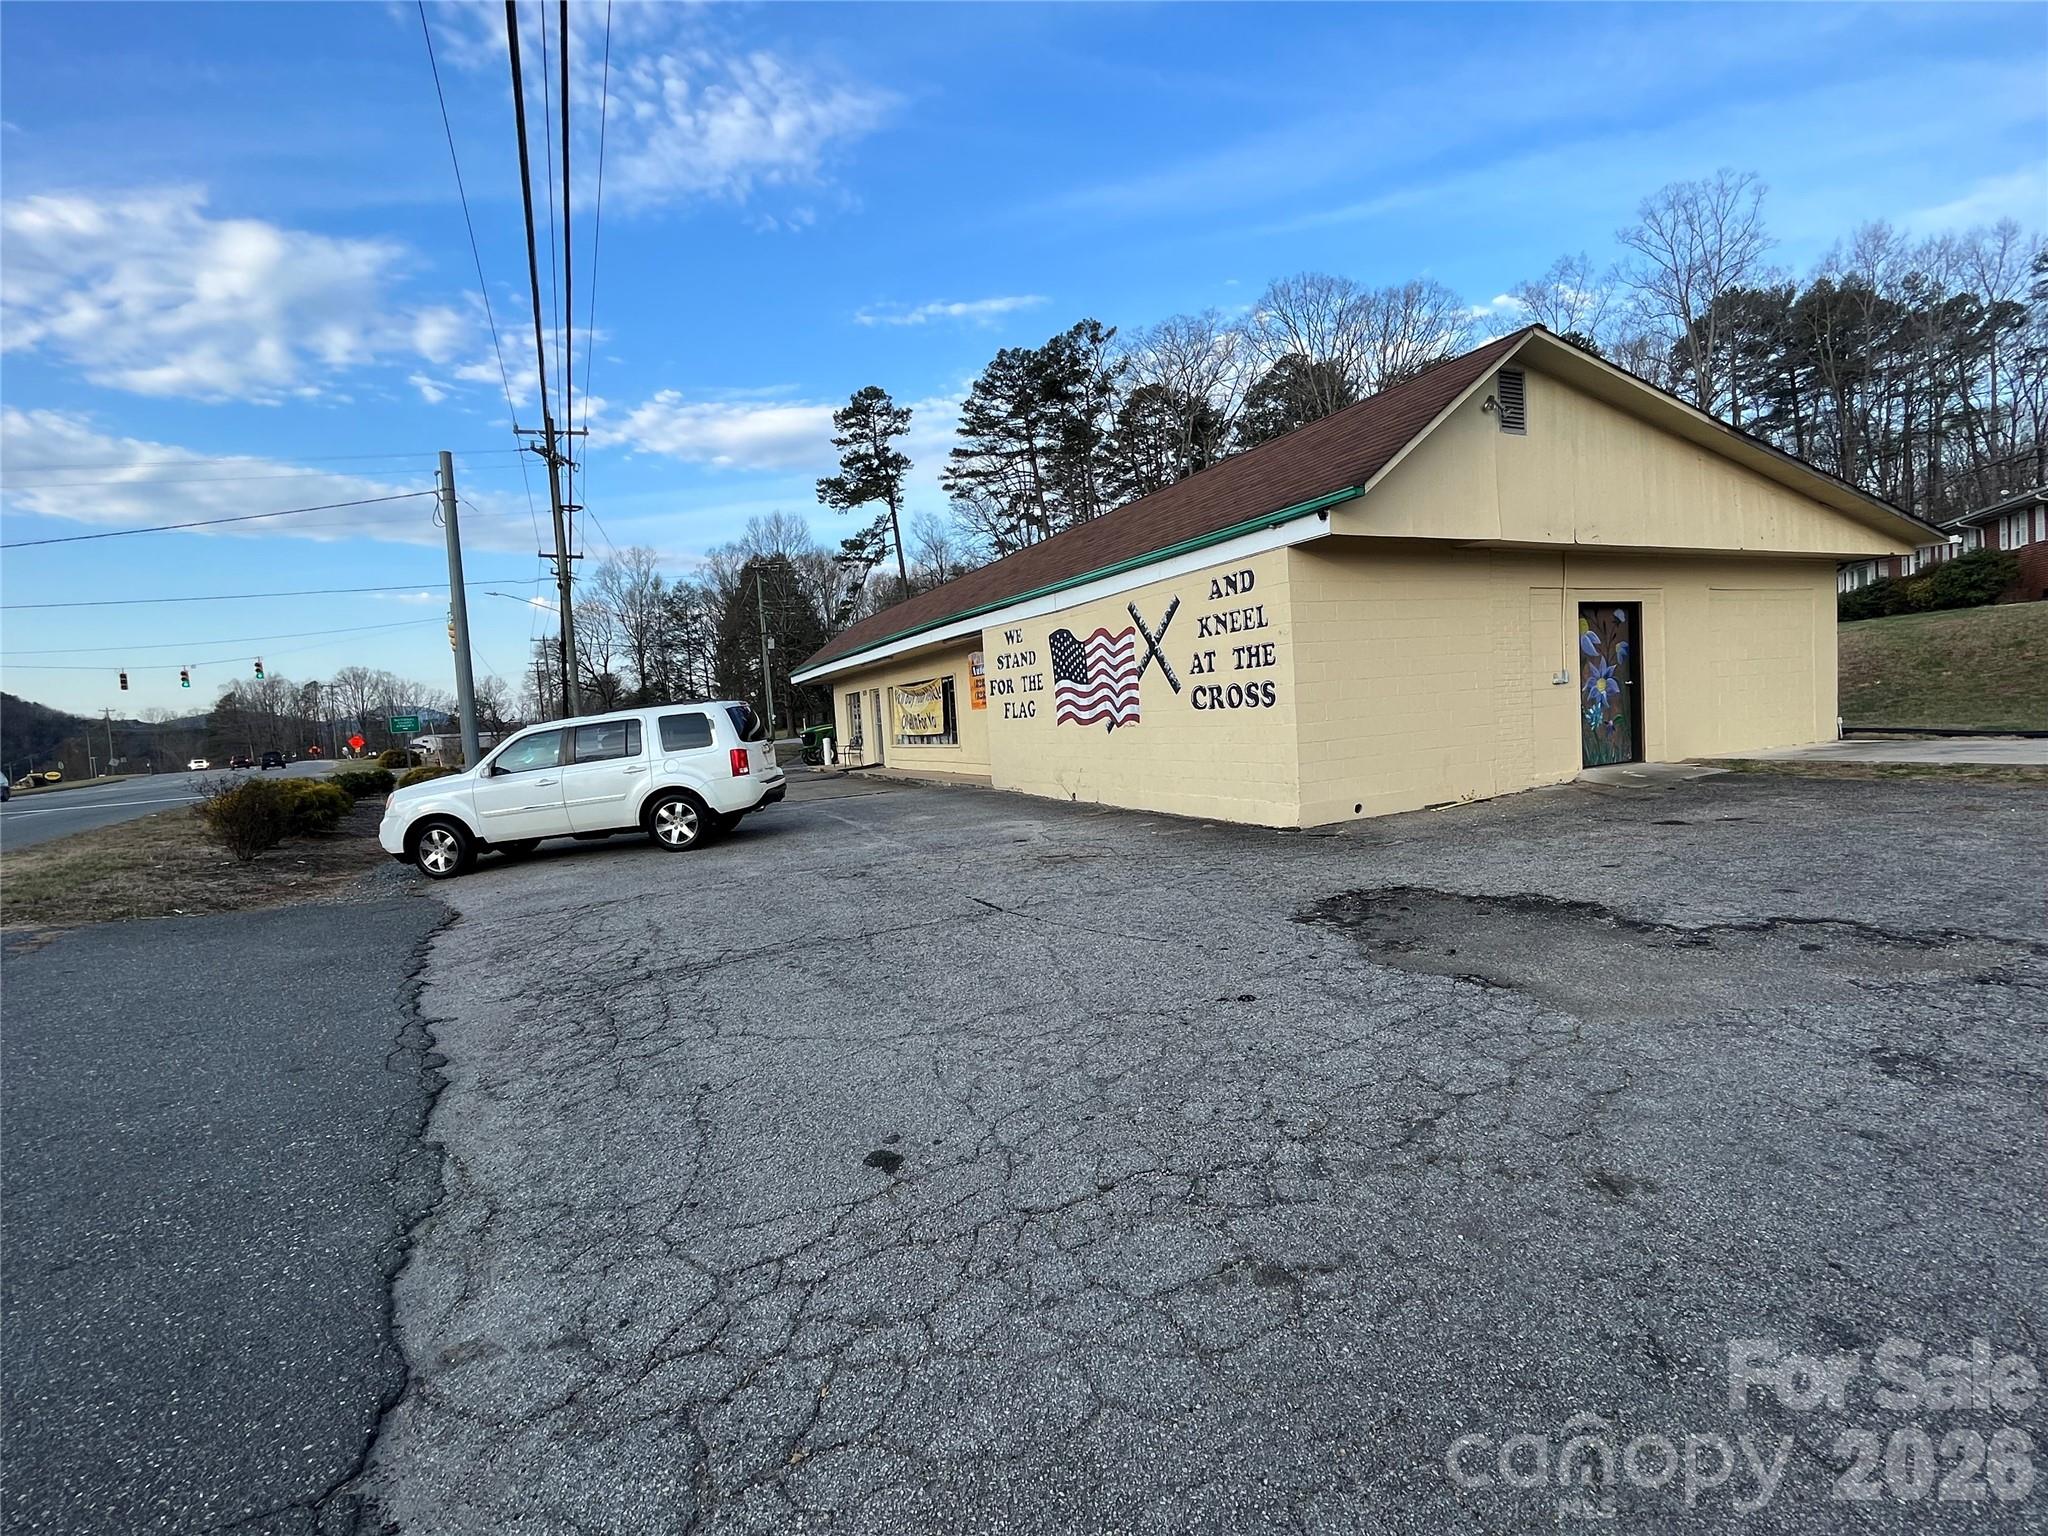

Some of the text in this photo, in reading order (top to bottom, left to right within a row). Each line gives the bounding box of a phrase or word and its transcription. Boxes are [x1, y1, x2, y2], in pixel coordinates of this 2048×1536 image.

[1208, 568, 1255, 600] AND
[1196, 604, 1269, 639] KNEEL
[1004, 628, 1023, 646] WE
[996, 650, 1036, 671] STAND
[1189, 642, 1276, 675] AT THE
[989, 678, 1014, 697] FOR
[1020, 673, 1044, 693] THE
[1190, 679, 1277, 711] CROSS
[1003, 700, 1036, 720] FLAG
